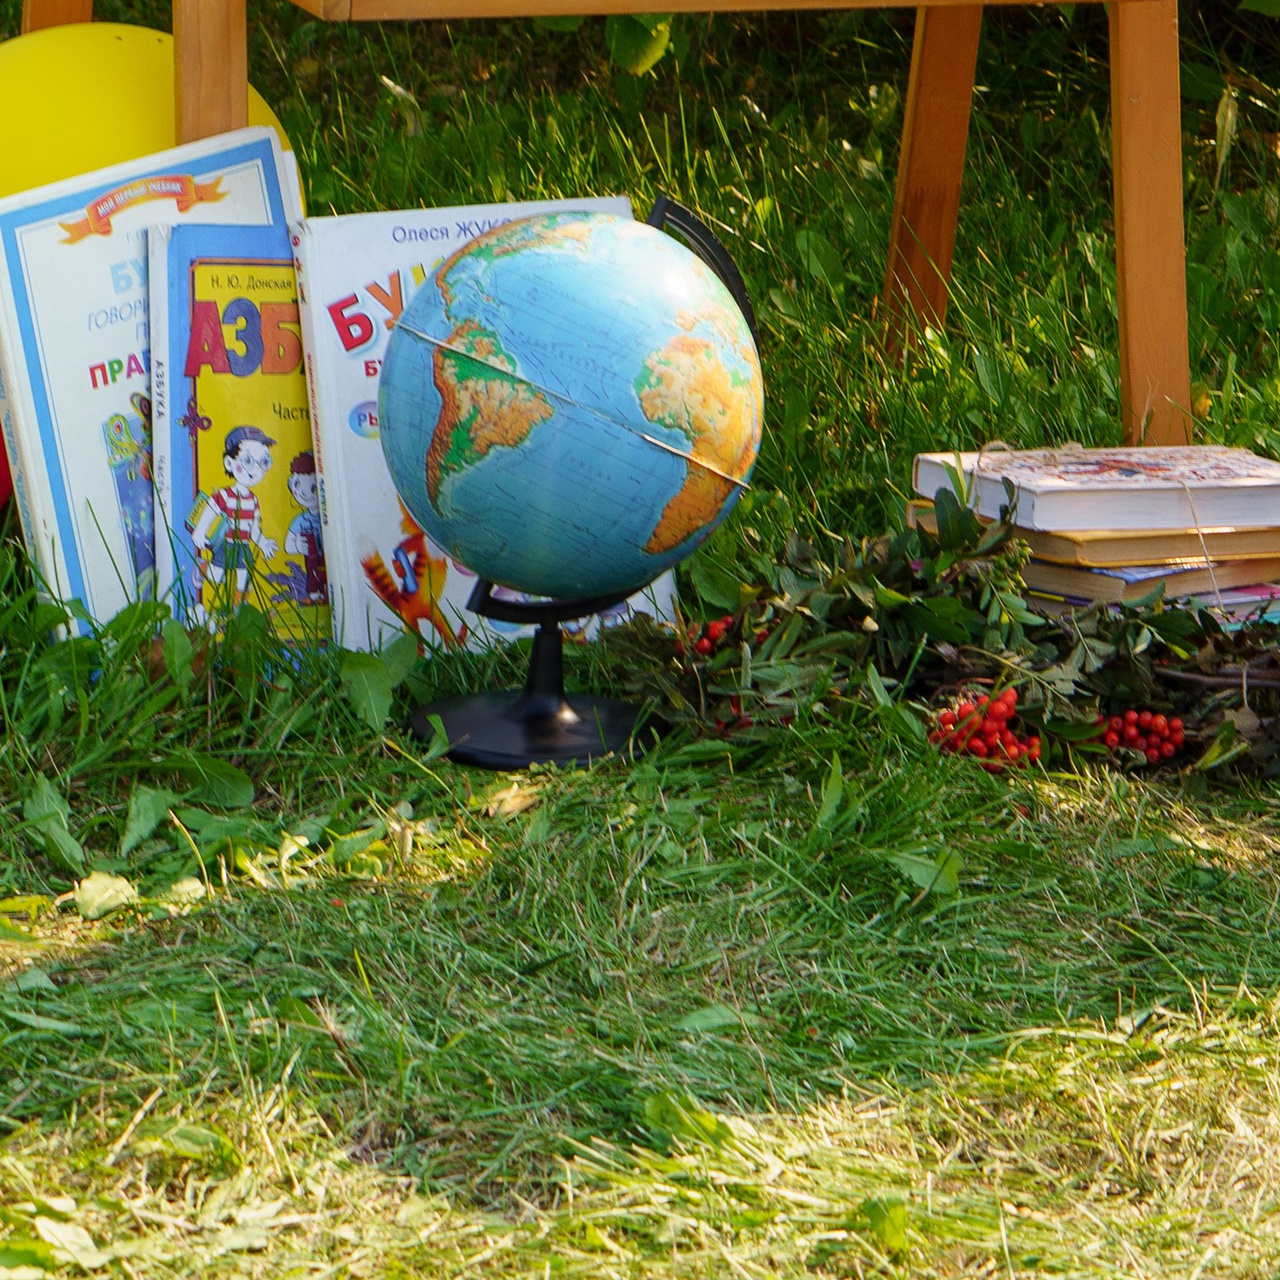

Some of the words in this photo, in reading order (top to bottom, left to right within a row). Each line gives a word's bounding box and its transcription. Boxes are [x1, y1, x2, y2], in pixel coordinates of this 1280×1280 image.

[96, 196, 117, 219] МОЙ
[392, 225, 450, 244] Олеся
[211, 275, 222, 289] Н.
[227, 274, 242, 289] Ю.
[246, 275, 292, 292] Донская
[184, 298, 304, 376] АЗБ
[154, 360, 165, 421] АЗБУКА
